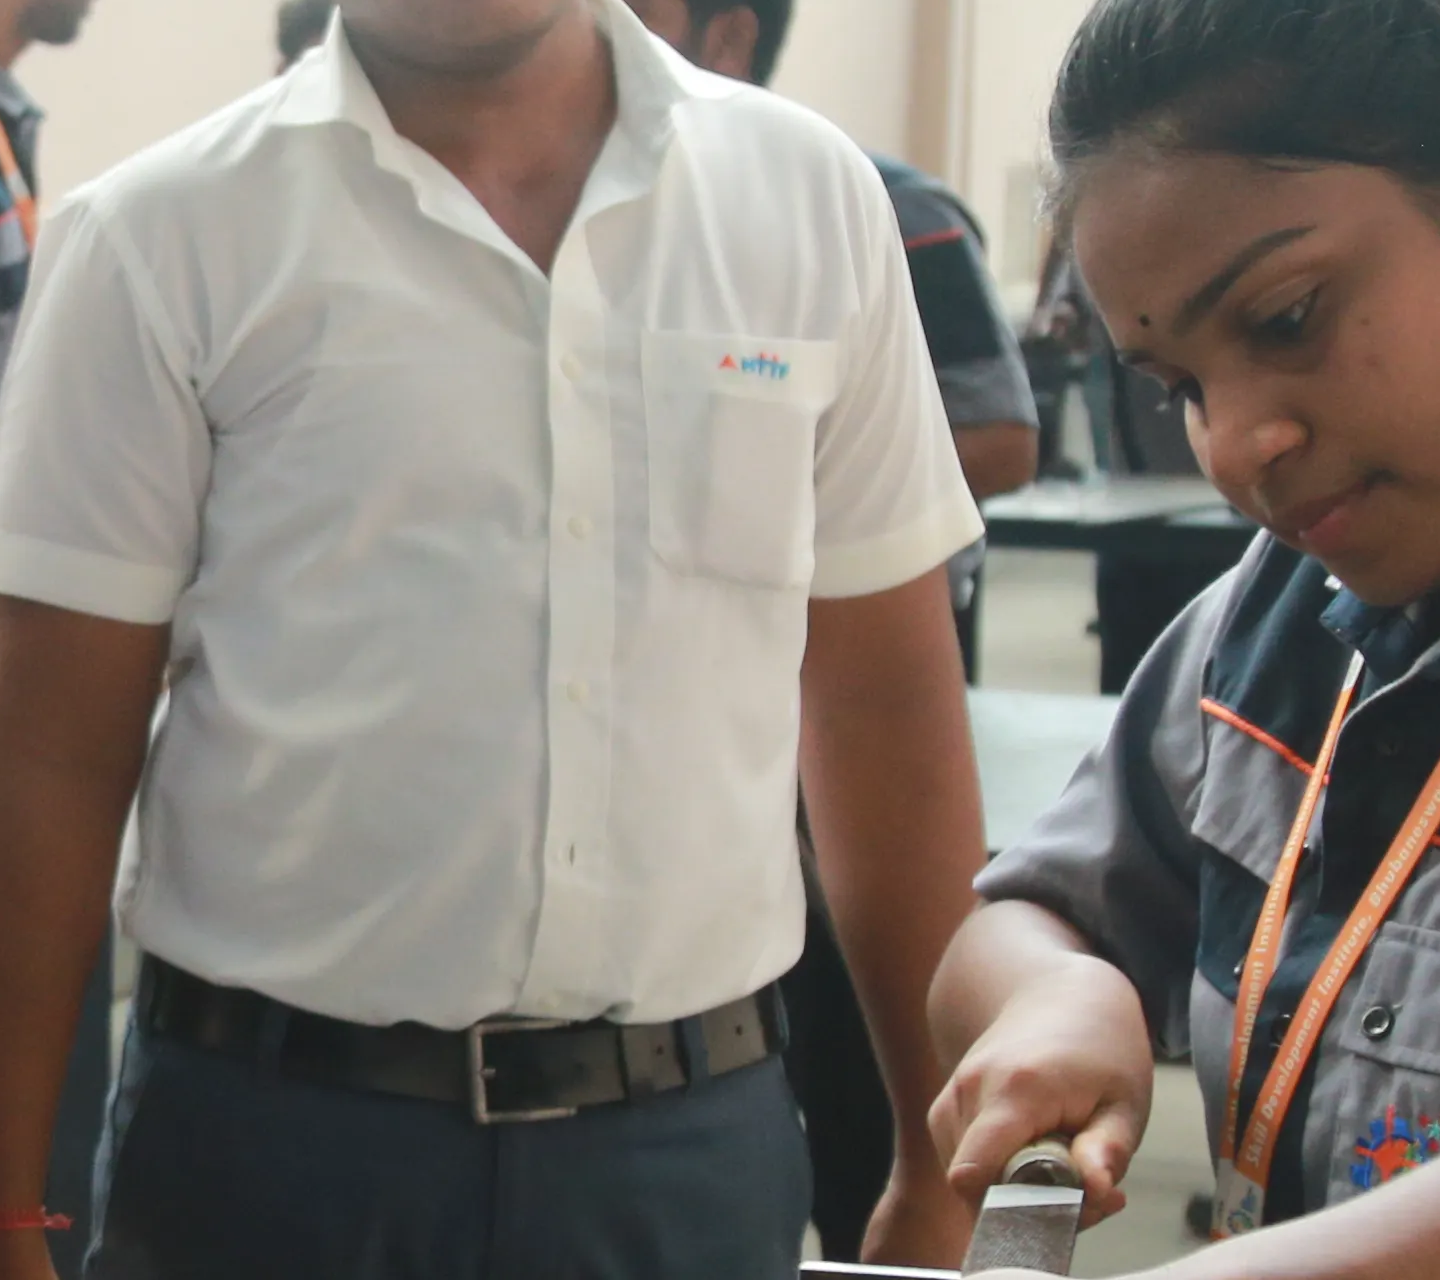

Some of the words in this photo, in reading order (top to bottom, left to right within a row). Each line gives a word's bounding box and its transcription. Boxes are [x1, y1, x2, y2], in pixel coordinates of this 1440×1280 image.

[1245, 1122, 1269, 1169] Skill
[1261, 999, 1321, 1121] Development
[1318, 913, 1373, 999] Institute,
